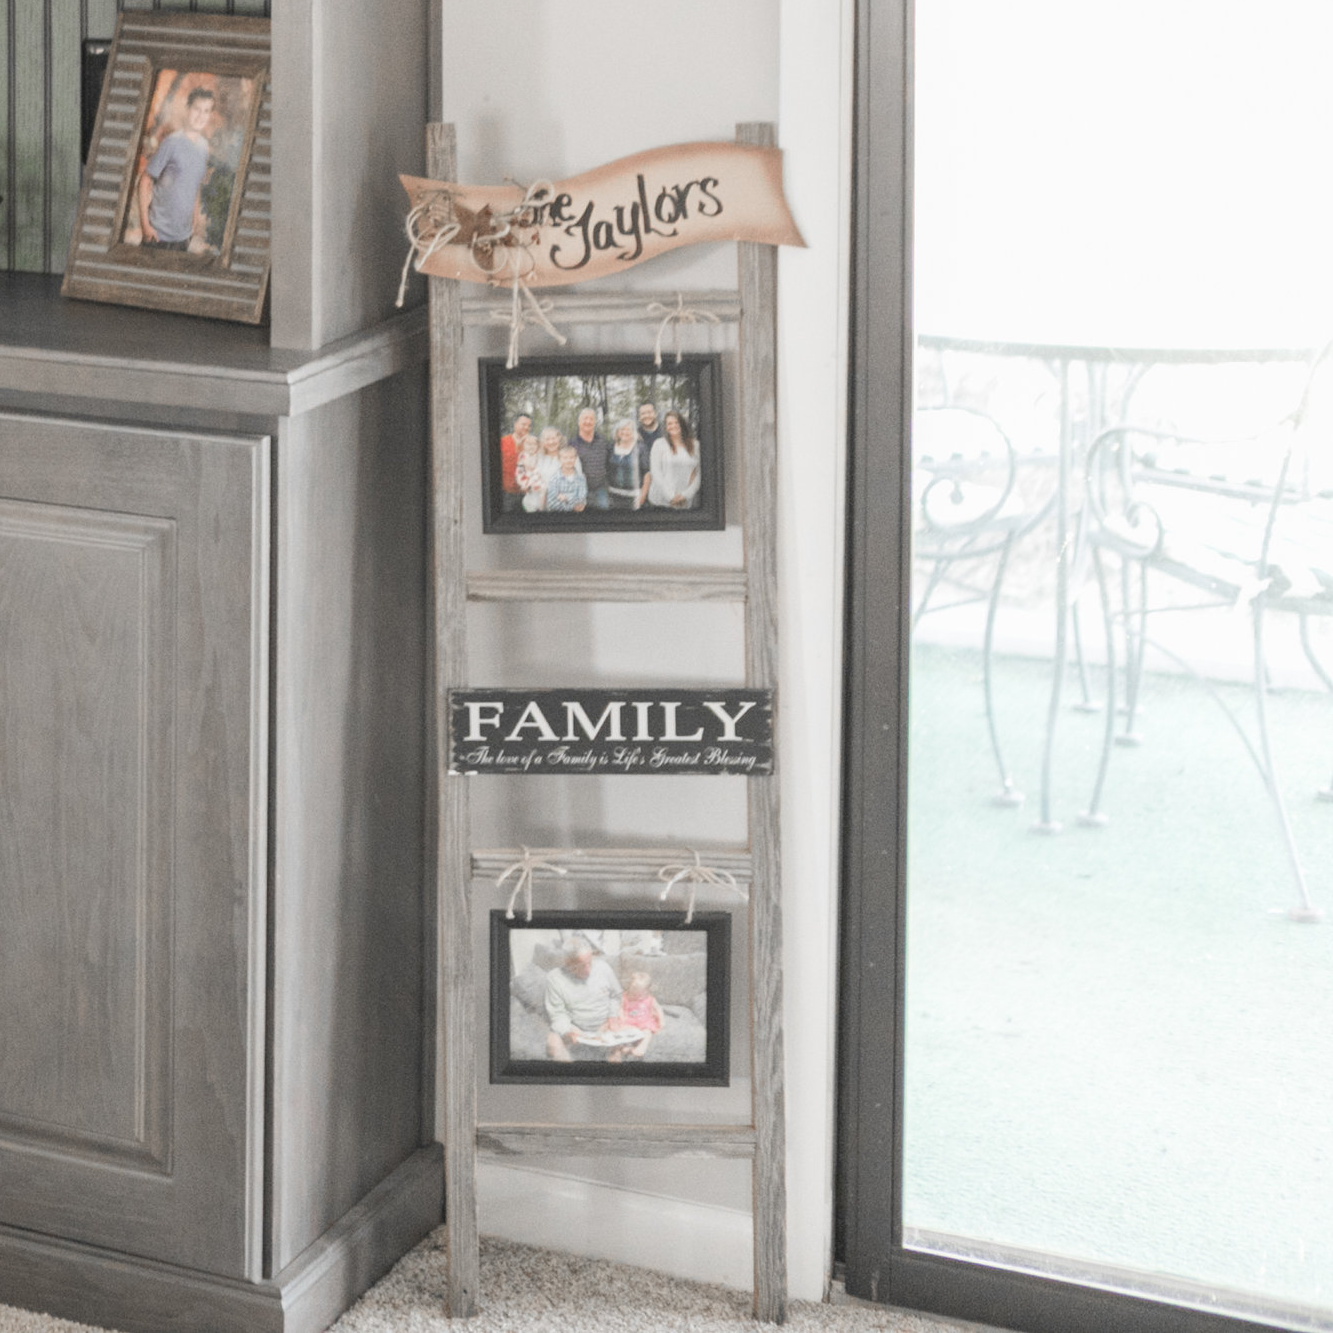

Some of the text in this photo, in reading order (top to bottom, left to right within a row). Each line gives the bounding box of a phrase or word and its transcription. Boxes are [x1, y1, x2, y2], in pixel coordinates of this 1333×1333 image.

[463, 701, 757, 742] FAMILY
[467, 746, 494, 764] The
[496, 749, 519, 765] love
[521, 748, 538, 771] of
[534, 755, 542, 764] a
[547, 746, 597, 771] Family
[599, 752, 608, 765] is
[649, 746, 701, 768] Greatest
[703, 746, 757, 771] Blessing
